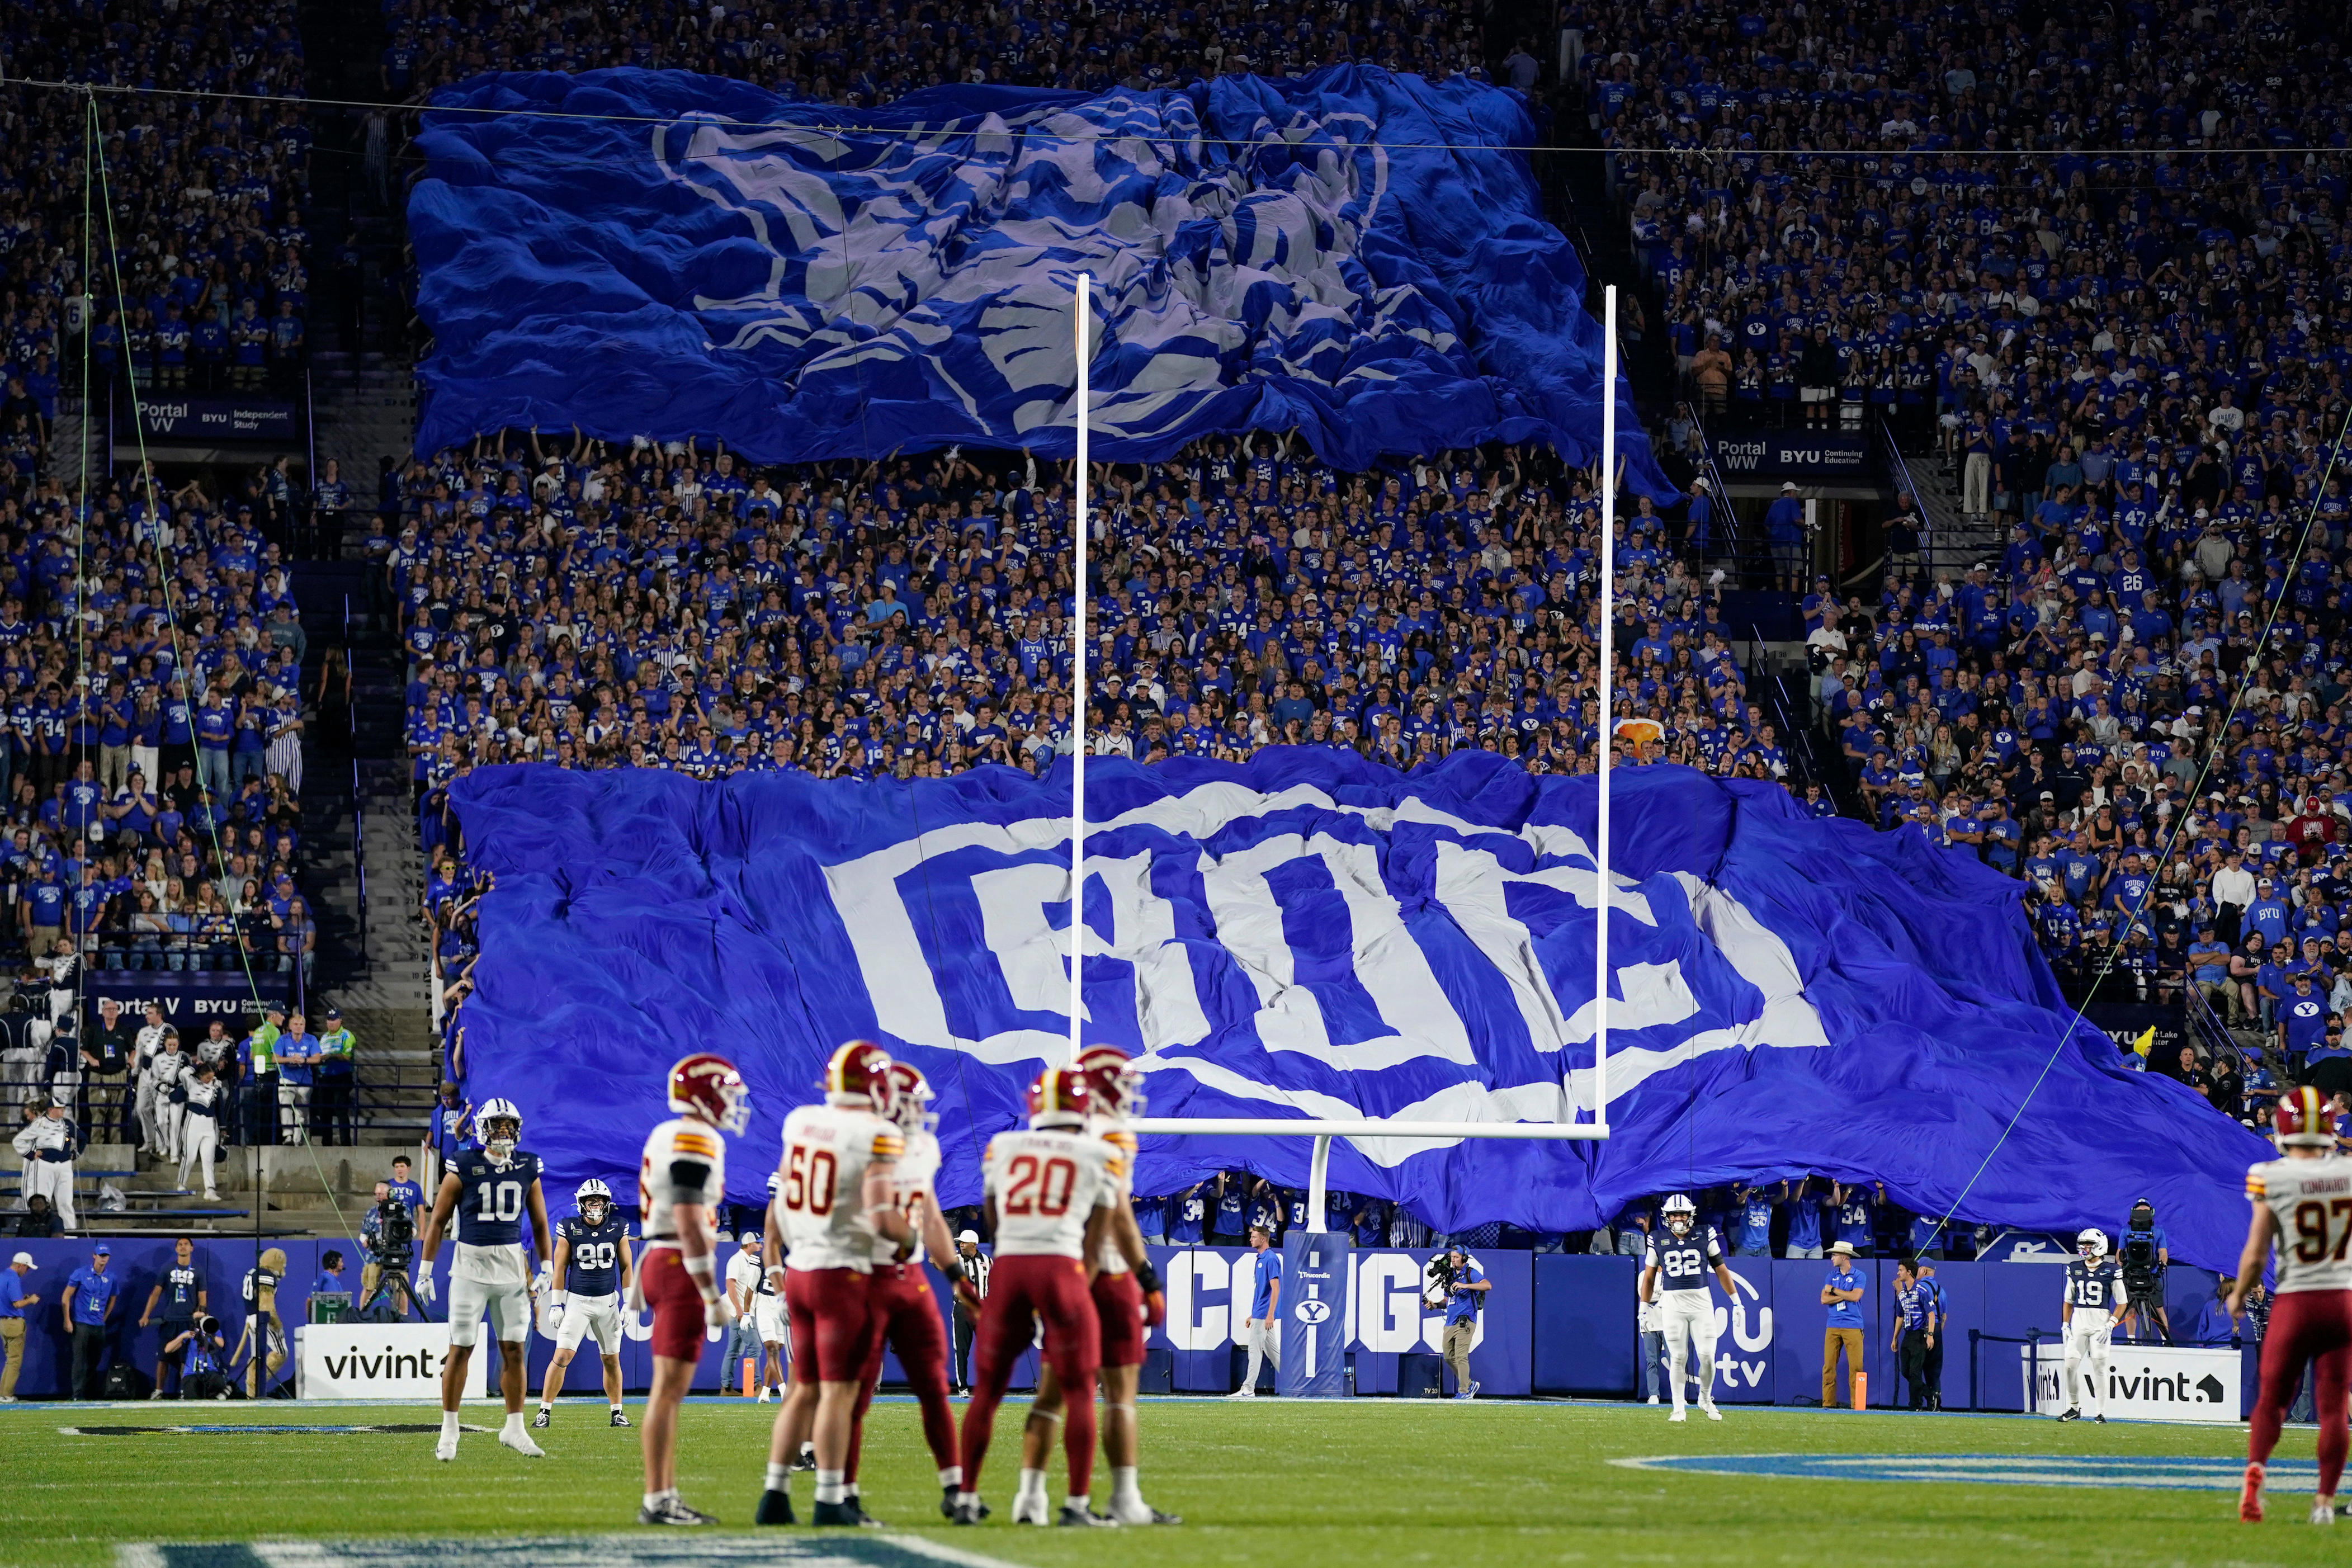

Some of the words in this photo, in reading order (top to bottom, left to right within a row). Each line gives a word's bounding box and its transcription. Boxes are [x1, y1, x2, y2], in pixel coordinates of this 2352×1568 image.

[68, 306, 79, 324] 6
[1787, 318, 1803, 327] COUGS
[138, 402, 188, 418] Portal
[234, 410, 287, 420] Independent
[202, 414, 227, 423] BYU
[234, 421, 259, 431] Study
[1718, 441, 1766, 455] Portal
[1825, 450, 1863, 459] Continuing
[1726, 456, 1758, 470] WW
[1780, 450, 1820, 463] BYU
[1212, 465, 1230, 479] 34
[2324, 502, 2342, 511] COUGS
[1470, 518, 1484, 528] COUGS
[2126, 511, 2147, 527] 47
[2123, 575, 2143, 591] 26
[803, 591, 821, 602] BYU
[414, 631, 433, 642] COUGS
[1024, 645, 1042, 653] BYU
[1089, 649, 1098, 658] 26
[1031, 654, 1037, 664] 3
[44, 718, 66, 737] 34
[2124, 716, 2143, 726] COUGS
[2151, 749, 2166, 758] BYU
[73, 786, 95, 796] COUGS
[2303, 821, 2323, 831] IOWA
[2124, 880, 2145, 889] COUGS
[37, 887, 61, 898] COUGS
[2259, 908, 2280, 921] BYU
[165, 997, 180, 1014] V
[194, 999, 237, 1014] BYU
[2105, 1031, 2137, 1045] YU
[787, 1146, 837, 1216] 50
[1006, 1156, 1076, 1216] 20
[478, 1181, 523, 1222] 10
[1332, 1191, 1352, 1211] 34
[1183, 1199, 1205, 1222] 34
[1293, 1202, 1305, 1224] 3
[1841, 1203, 1867, 1225] 34
[1252, 1205, 1277, 1233] 34
[2297, 1198, 2352, 1264] 97
[577, 1243, 615, 1270] 90
[1663, 1249, 1701, 1277] 82
[170, 1269, 195, 1278] GO
[2075, 1280, 2103, 1306] 19
[324, 1346, 439, 1379] vivint
[1716, 1353, 1766, 1388] tv
